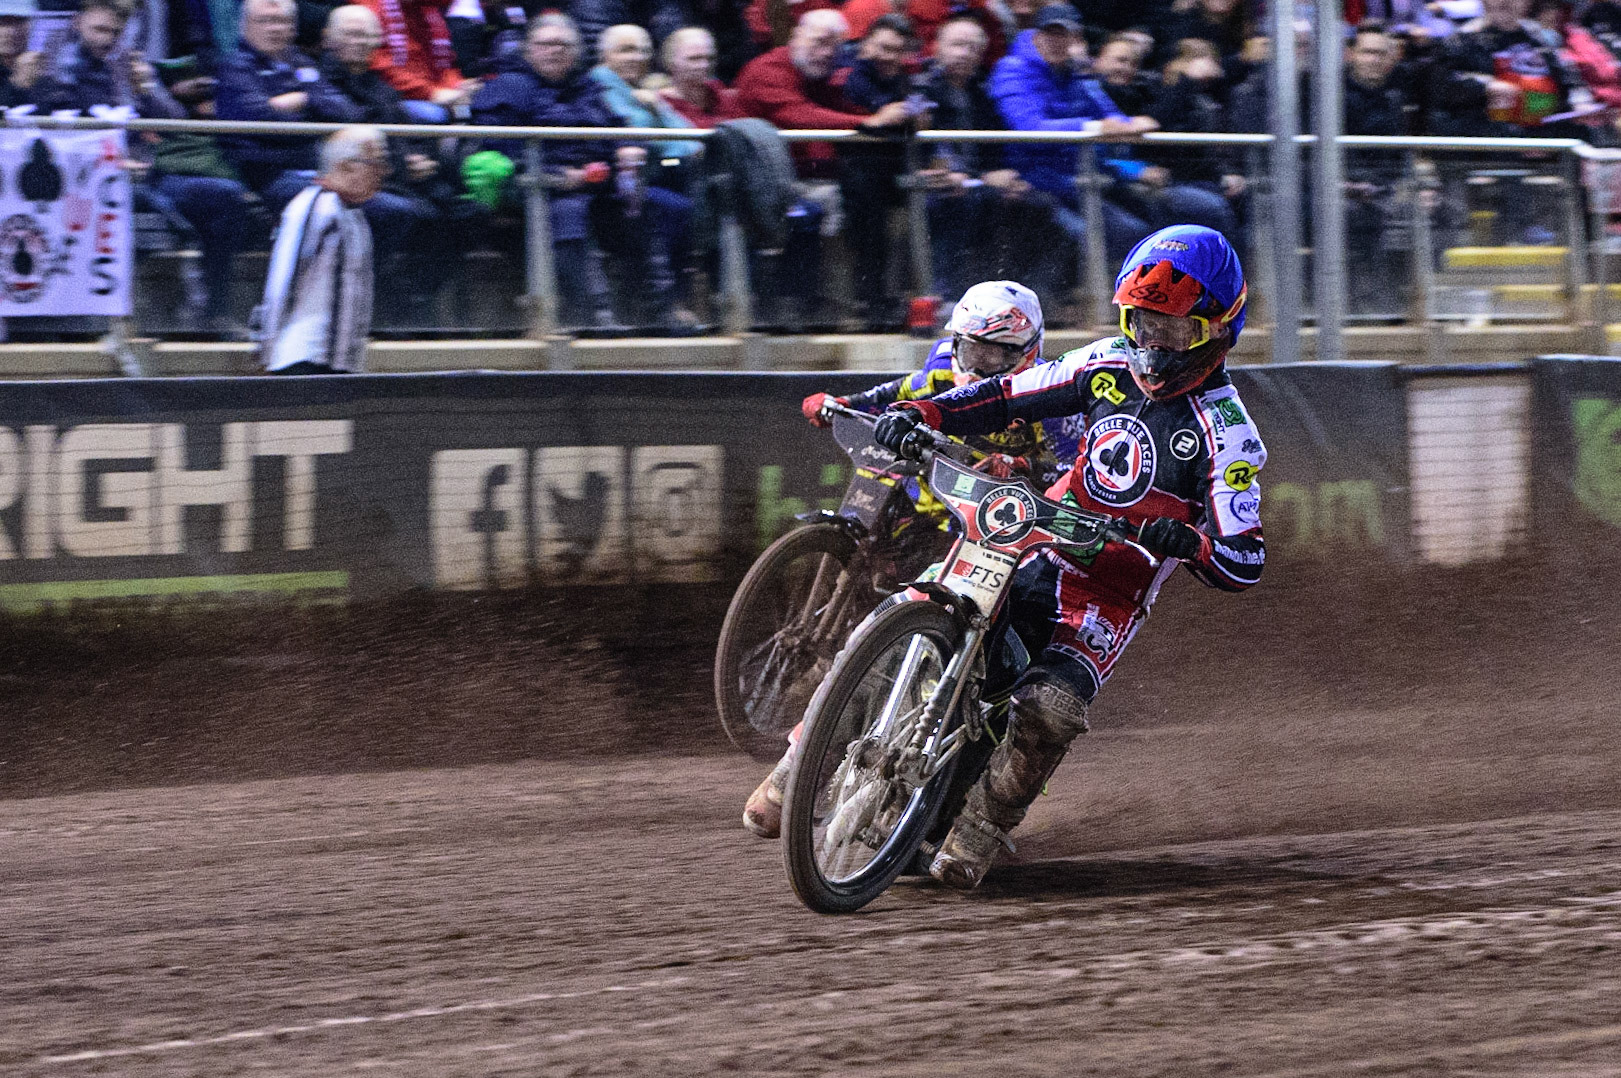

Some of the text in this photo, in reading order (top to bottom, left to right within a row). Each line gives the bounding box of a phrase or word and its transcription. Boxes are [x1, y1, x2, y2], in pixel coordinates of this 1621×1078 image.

[1094, 419, 1151, 474] BELLE VUE ACES
[986, 489, 1034, 518] BELLE VUE ACES
[969, 565, 1004, 588] FTS
